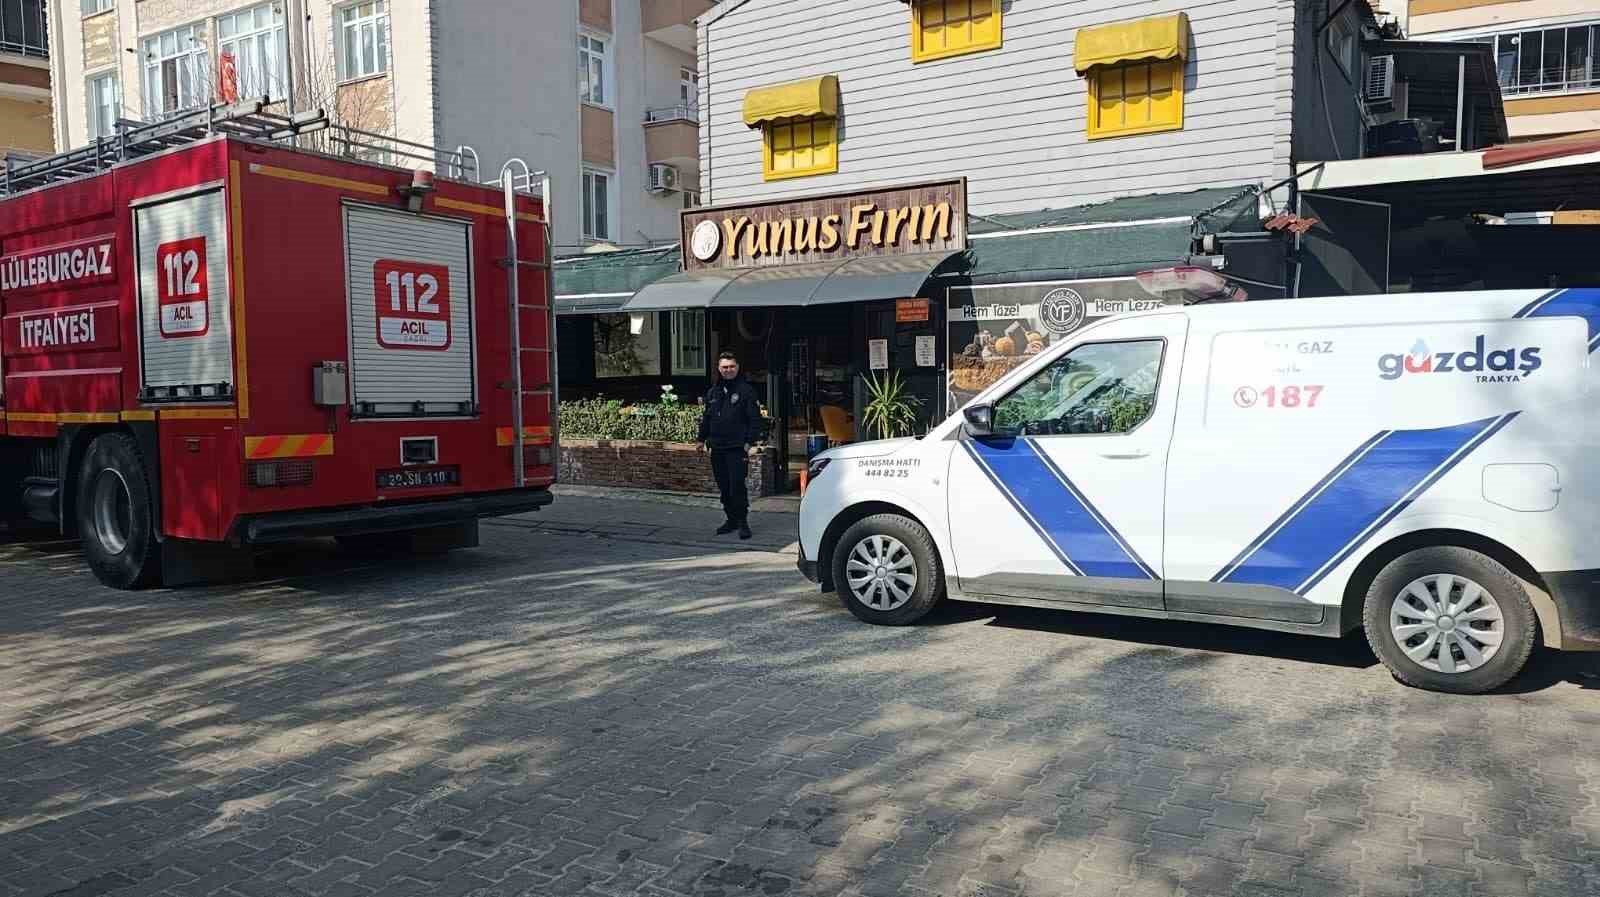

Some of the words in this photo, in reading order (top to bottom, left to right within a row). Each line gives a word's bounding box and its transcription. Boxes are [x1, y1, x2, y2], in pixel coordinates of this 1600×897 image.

[722, 214, 840, 257] Yunus
[1, 244, 112, 290] LÜLEBURGAZ
[163, 250, 201, 297] 112
[385, 270, 440, 314] 112
[963, 305, 988, 317] Hem
[1095, 299, 1123, 312] Hem
[19, 306, 96, 348] İTFAİYESİ
[1296, 340, 1334, 354] GAZ
[1474, 375, 1521, 384] TRAKYA
[1260, 385, 1325, 408] 187
[864, 469, 881, 477] 444
[883, 469, 896, 477] 82
[897, 469, 909, 478] 25
